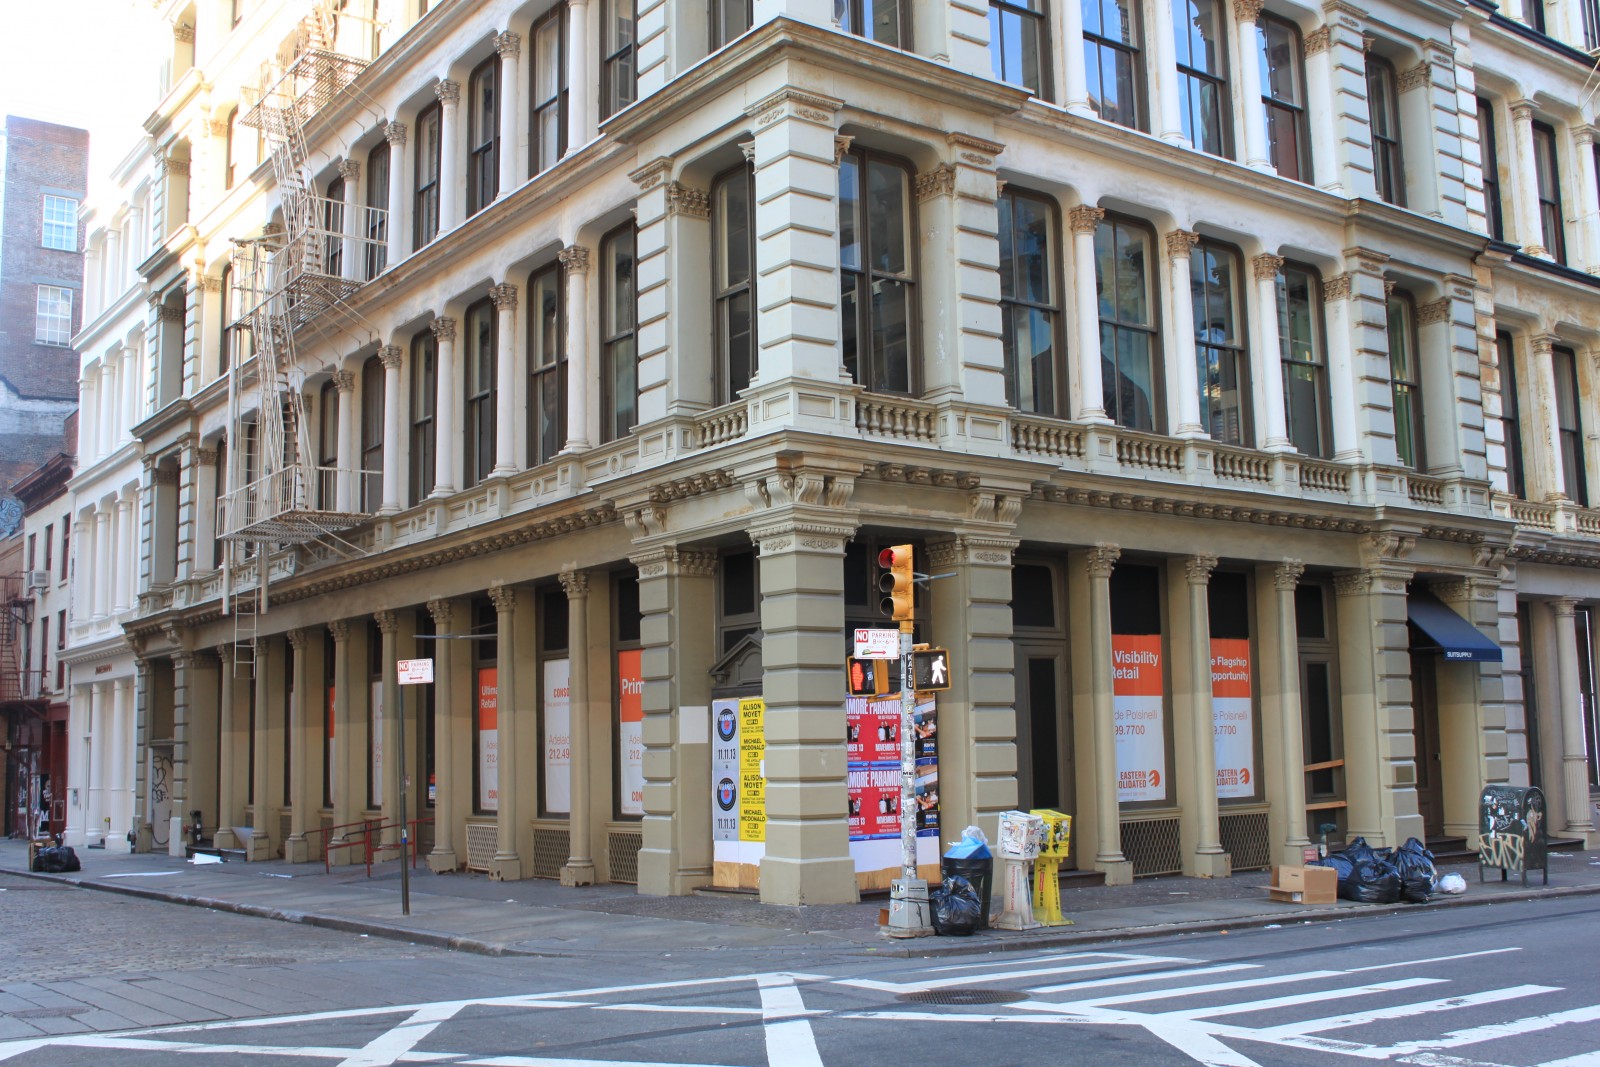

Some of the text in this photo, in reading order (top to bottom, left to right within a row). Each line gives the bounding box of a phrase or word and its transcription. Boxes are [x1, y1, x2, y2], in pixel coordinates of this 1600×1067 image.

[856, 632, 868, 642] NO
[1114, 650, 1159, 667] Visibility
[1217, 656, 1248, 669] Flagship
[400, 662, 409, 671] NO
[1126, 709, 1158, 720] Polsinelli
[875, 743, 896, 752] NOVEMBER
[549, 748, 570, 760] 212.49
[718, 748, 736, 760] 11.11.13
[1120, 771, 1147, 780] EASTERN
[717, 818, 736, 830] 11.11.13
[876, 815, 897, 825] NOVEMBER
